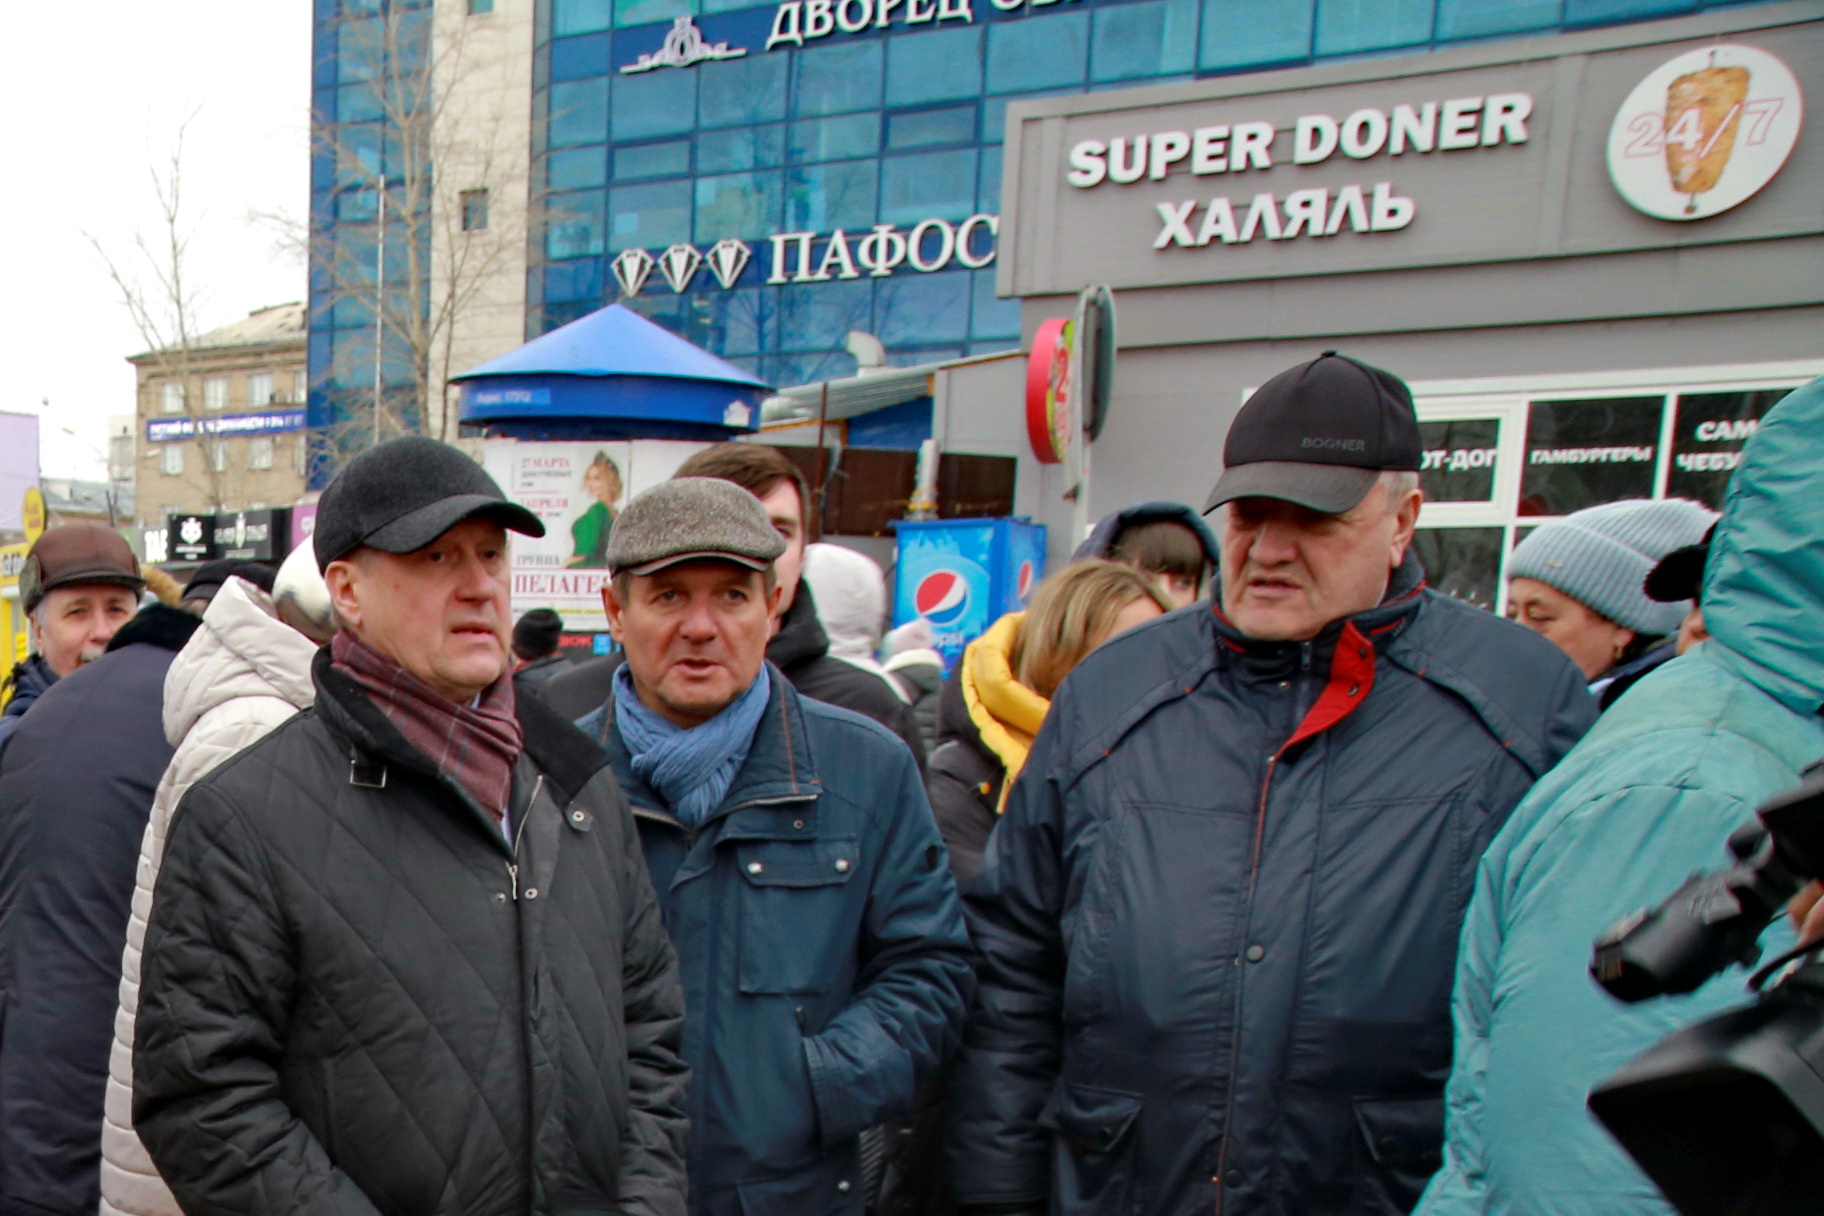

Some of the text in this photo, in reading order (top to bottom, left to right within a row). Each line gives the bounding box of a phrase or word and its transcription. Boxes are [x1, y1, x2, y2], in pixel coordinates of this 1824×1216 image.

[1067, 91, 1535, 189] SUPER DONER
[1622, 97, 1785, 160] 24/7
[1151, 181, 1417, 250] ХАЛЯЛЬ
[766, 213, 1000, 285] ПАФОС
[1695, 419, 1760, 442] САМ
[1301, 437, 1365, 452] BOGNER
[1530, 446, 1652, 465] ГАМБУРГЕРЫ
[1419, 447, 1498, 472] ОТ-ДОГ
[1676, 450, 1745, 472] ЧЕБУ
